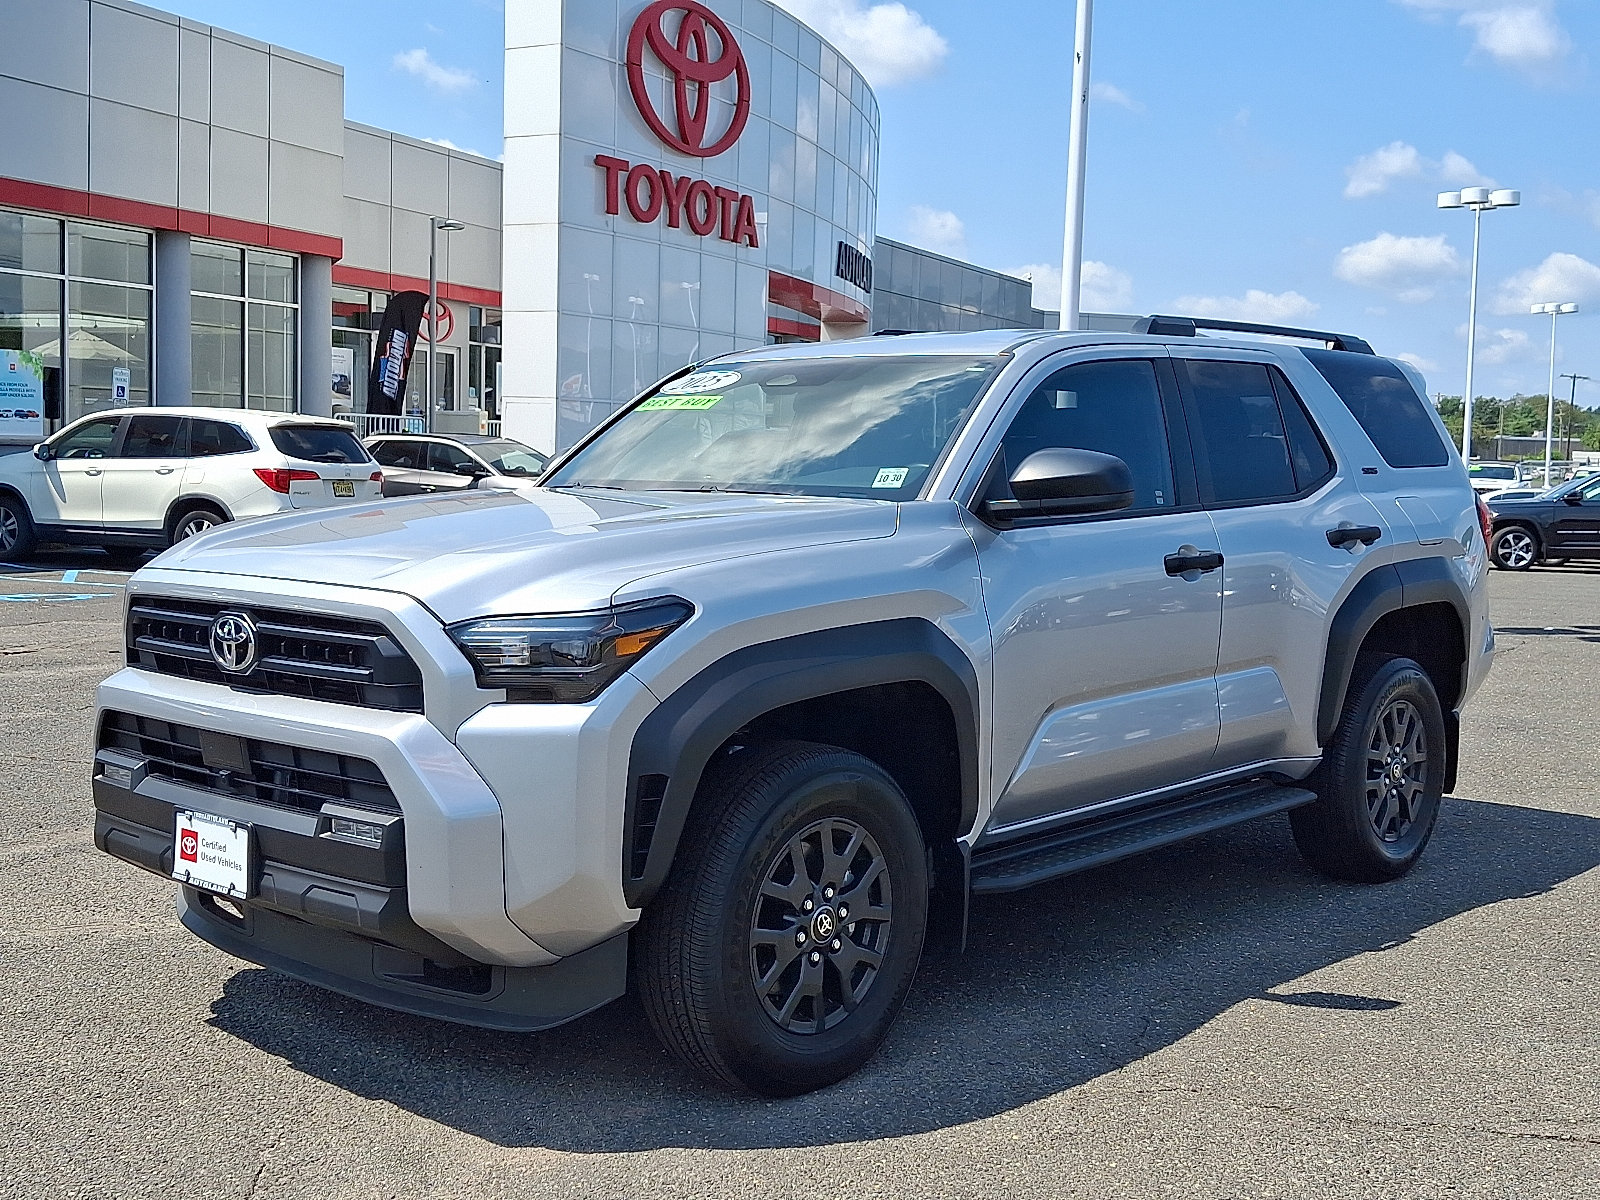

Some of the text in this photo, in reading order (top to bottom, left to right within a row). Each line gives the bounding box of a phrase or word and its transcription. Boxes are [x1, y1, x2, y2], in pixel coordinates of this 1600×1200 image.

[594, 154, 759, 248] TOYOTA
[383, 329, 408, 400] AUTOLAND
[641, 397, 718, 408] BEST BUY
[877, 473, 903, 482] 10 30
[201, 837, 227, 853] Certified
[200, 851, 243, 872] Used Vehicles
